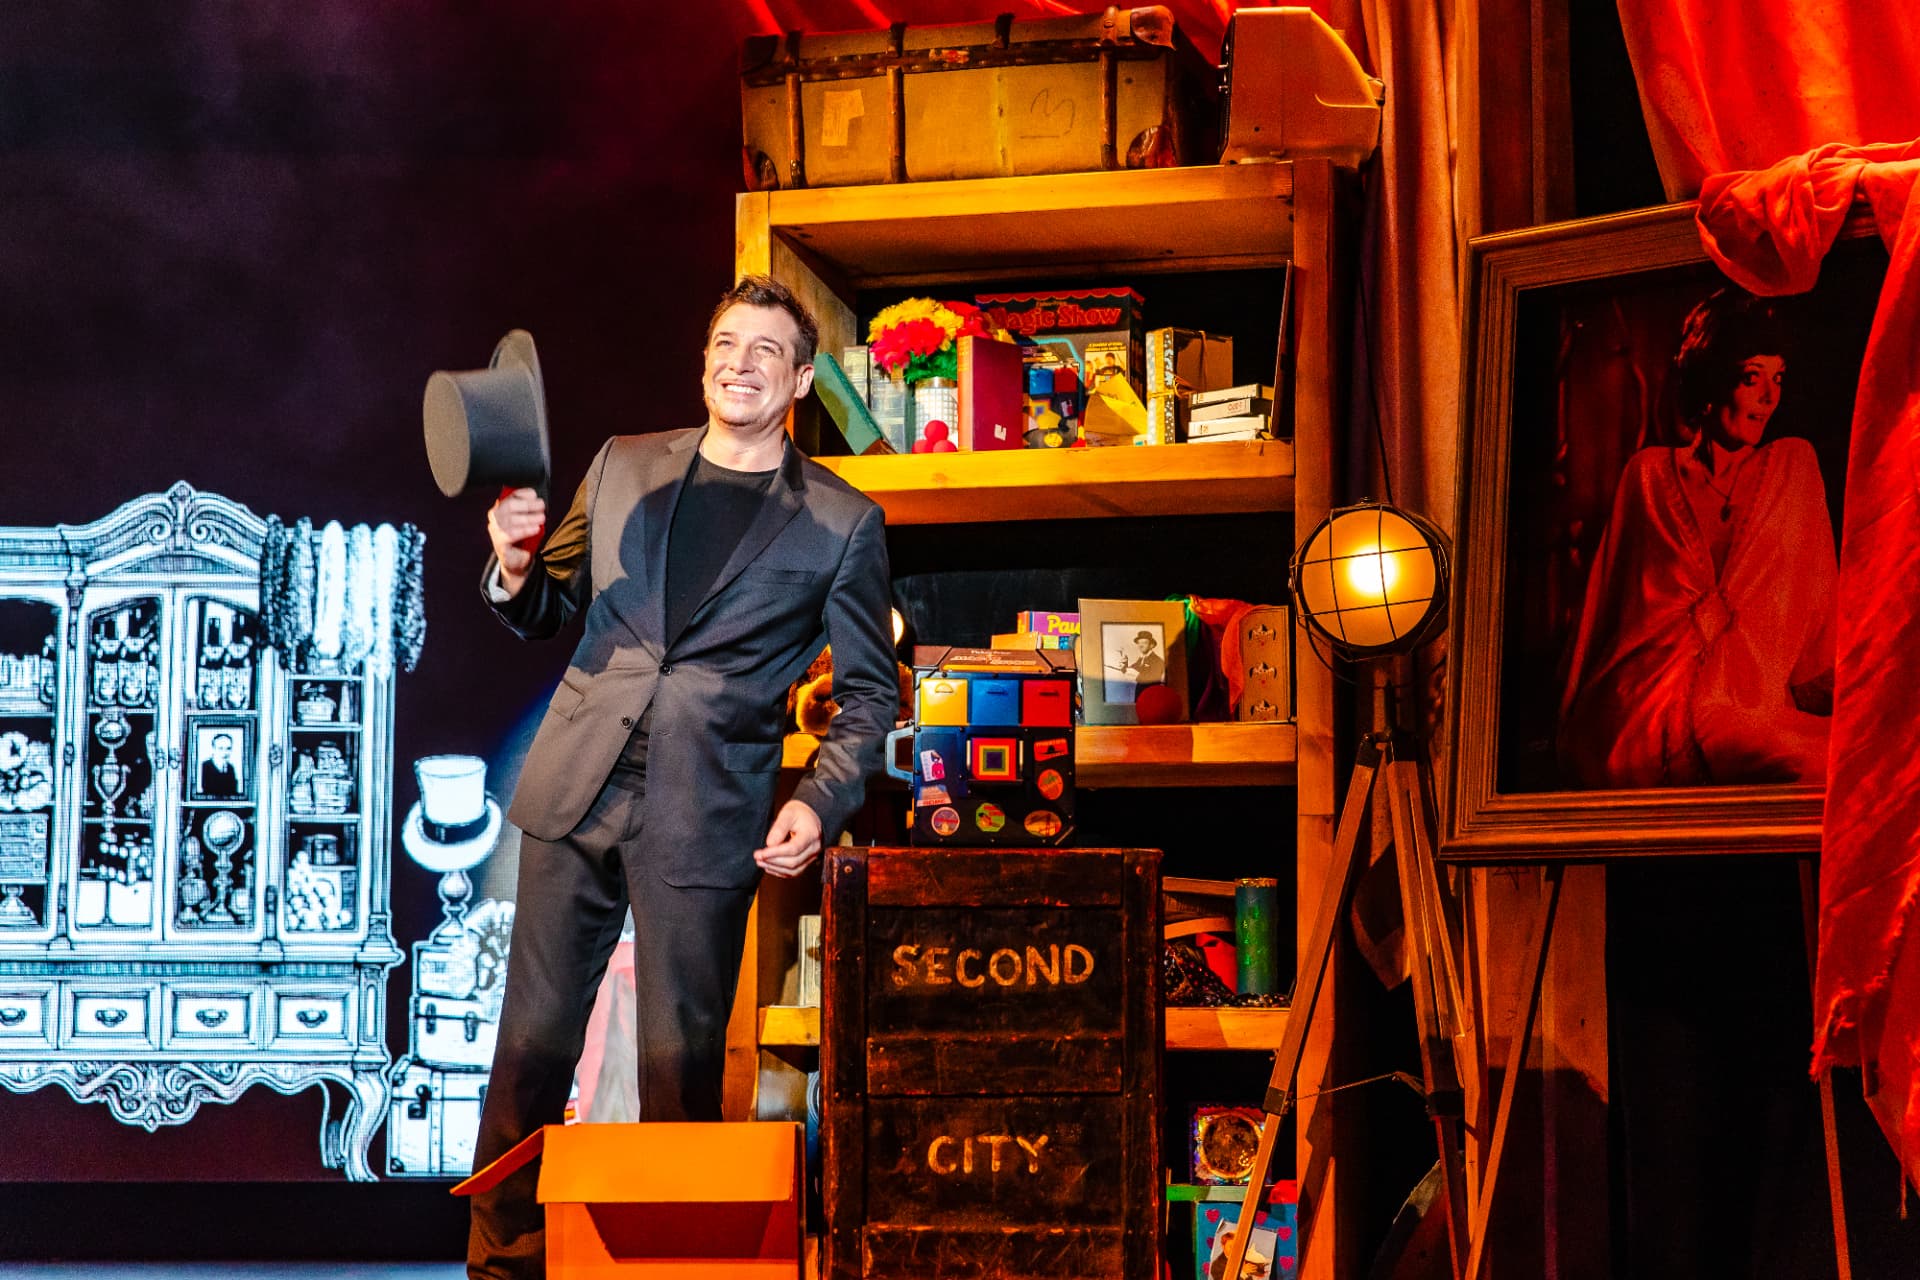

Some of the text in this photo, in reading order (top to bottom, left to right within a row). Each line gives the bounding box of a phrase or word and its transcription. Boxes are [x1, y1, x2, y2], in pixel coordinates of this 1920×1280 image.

[1057, 304, 1121, 326] Show
[891, 943, 1095, 988] SECOND
[927, 1134, 1049, 1175] CITY
